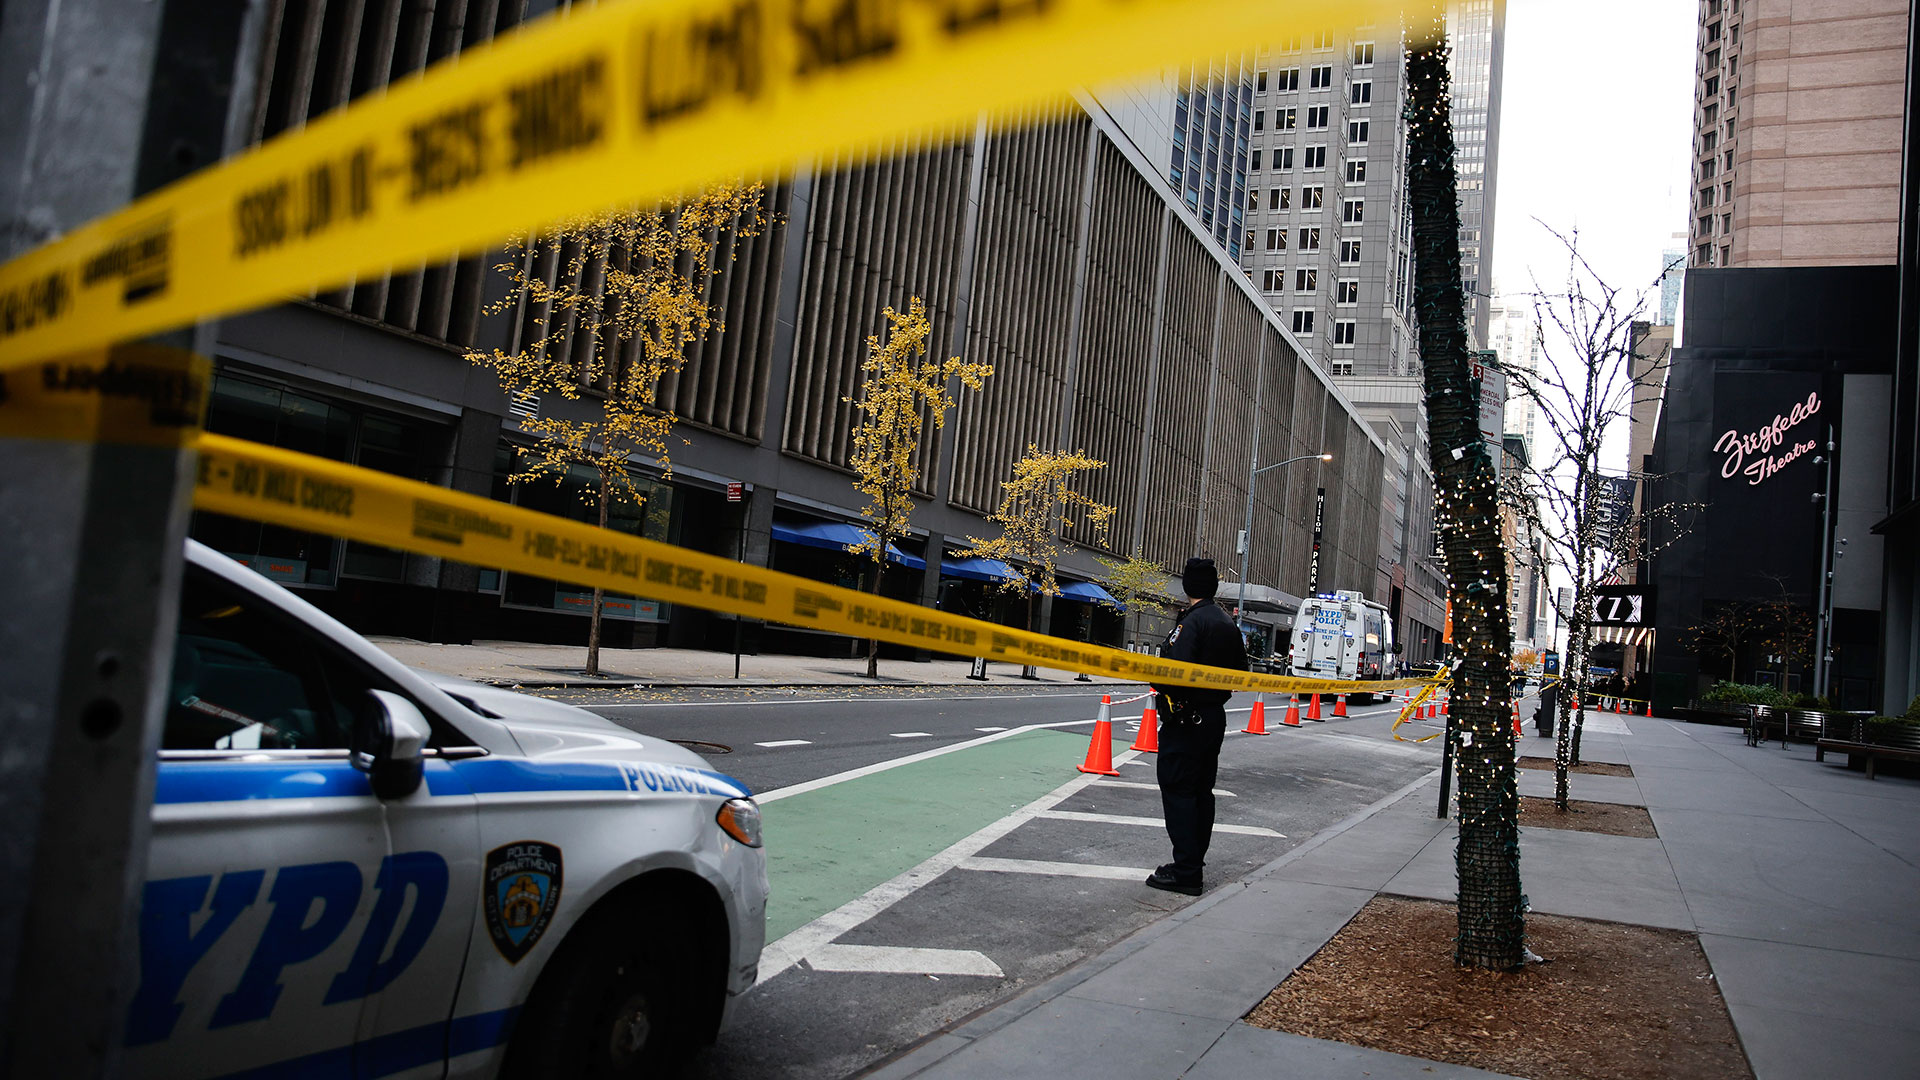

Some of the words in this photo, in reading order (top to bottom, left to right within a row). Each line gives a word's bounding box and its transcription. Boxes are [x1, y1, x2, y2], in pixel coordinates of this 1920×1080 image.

[1713, 392, 1821, 478] Ziegfeld
[1744, 440, 1816, 485] Theatre
[1315, 495, 1324, 532] Hilton
[1310, 551, 1319, 584] PARK
[1315, 617, 1341, 625] POLIC
[1318, 609, 1342, 618] NYPD
[1607, 597, 1622, 621] Z
[507, 845, 542, 859] POLICE
[490, 858, 558, 881] DEPARTMENT
